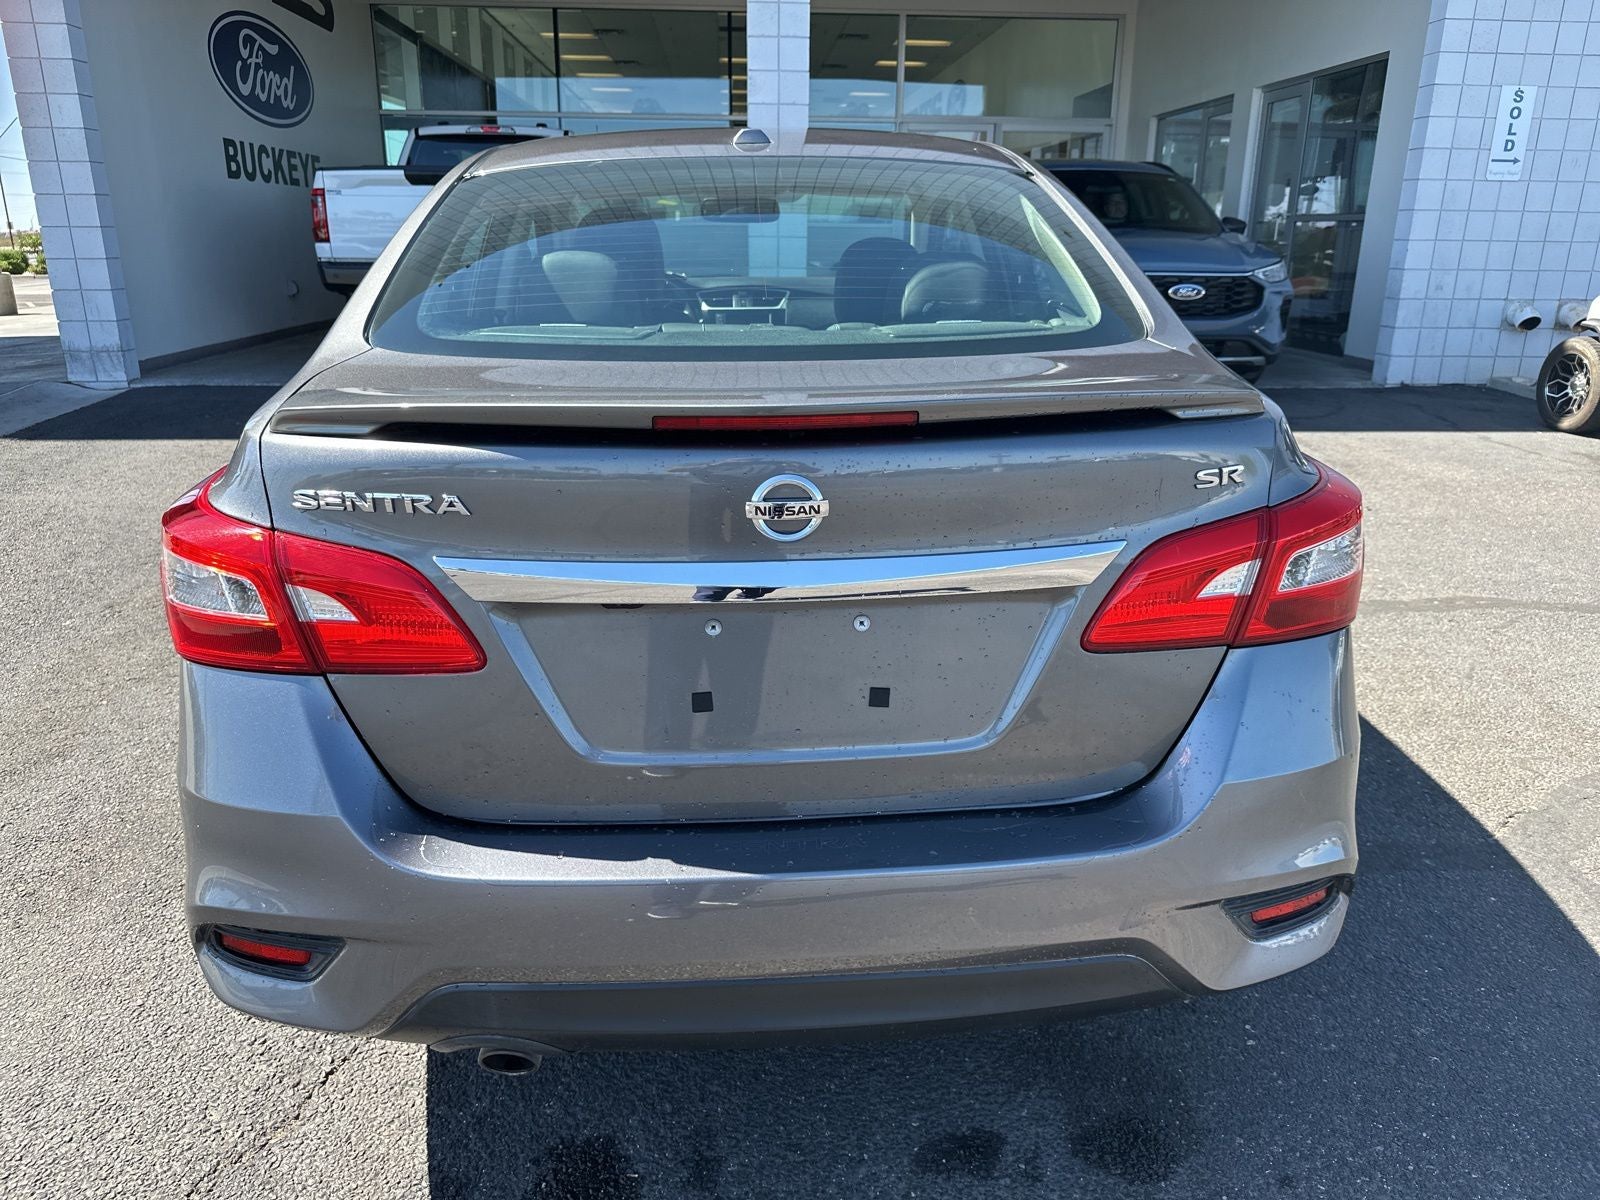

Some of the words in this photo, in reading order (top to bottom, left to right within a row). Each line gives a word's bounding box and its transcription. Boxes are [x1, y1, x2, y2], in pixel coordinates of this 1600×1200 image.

[236, 28, 296, 111] Ford
[1503, 88, 1525, 152] SOLD
[1194, 464, 1245, 489] SR
[292, 489, 471, 516] SENTRA
[754, 505, 821, 516] NISSAN
